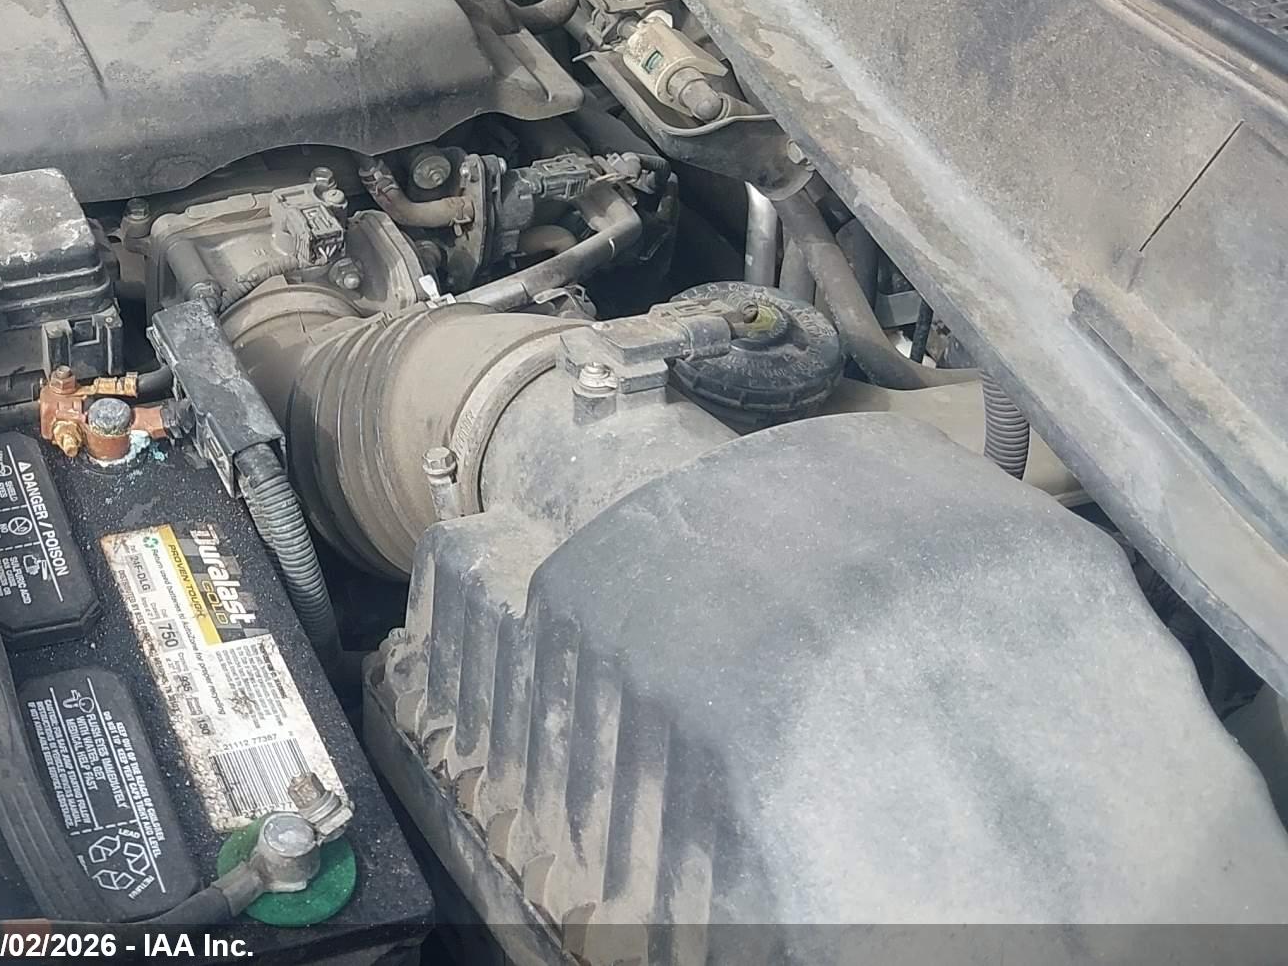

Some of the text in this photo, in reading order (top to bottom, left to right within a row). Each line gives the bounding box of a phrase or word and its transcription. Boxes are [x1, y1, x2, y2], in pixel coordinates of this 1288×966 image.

[4, 480, 18, 502] SHIELD
[21, 472, 69, 576] DANGER / POISON
[1, 557, 11, 569] CAN
[149, 548, 165, 568] Return
[8, 555, 31, 604] SULFURIC ACID
[128, 555, 151, 591] 24F-DLG
[159, 569, 172, 584] used
[166, 543, 205, 617] PROVEN TOUGH
[187, 523, 258, 626] Duralast
[165, 585, 183, 611] batteries
[200, 579, 229, 625] GOLD
[156, 622, 180, 648] 750
[180, 620, 200, 651] AutoZone
[193, 652, 205, 661] for
[178, 676, 193, 691] 935
[197, 661, 214, 684] proper
[207, 685, 227, 715] recycling
[102, 710, 113, 721] DO
[106, 720, 118, 734] NOT
[196, 719, 211, 735] 130
[64, 718, 98, 791] MEDICAL HELP FAST
[75, 715, 90, 735] WITH
[92, 765, 106, 781] GET
[116, 747, 128, 764] KEEP
[42, 698, 91, 824] CAUTION: FOR SAFE JUMP STARTING FOLLOW
[85, 713, 127, 809] FLUSH EYES IMMEDIATELY
[115, 721, 165, 841] KEEP OUT OF THE REACH OF CHILDREN
[122, 764, 135, 782] VENT
[128, 781, 141, 800] CAPS
[134, 800, 149, 821] TIGHT
[118, 828, 140, 838] LEAD
[142, 820, 154, 835] AND
